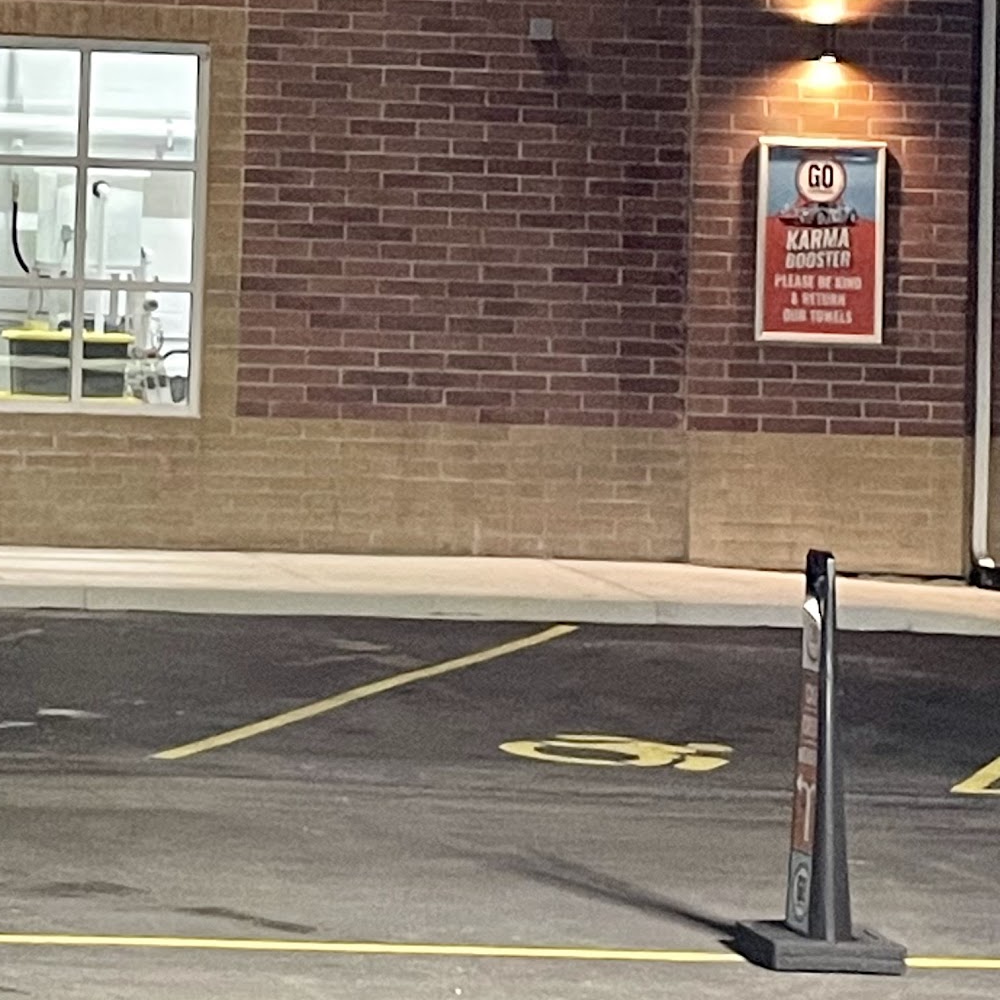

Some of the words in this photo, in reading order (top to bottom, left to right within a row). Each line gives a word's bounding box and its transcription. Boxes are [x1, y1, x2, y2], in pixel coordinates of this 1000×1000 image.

[808, 164, 834, 188] GO
[785, 227, 850, 250] KARMA
[785, 250, 852, 269] BOOSTER
